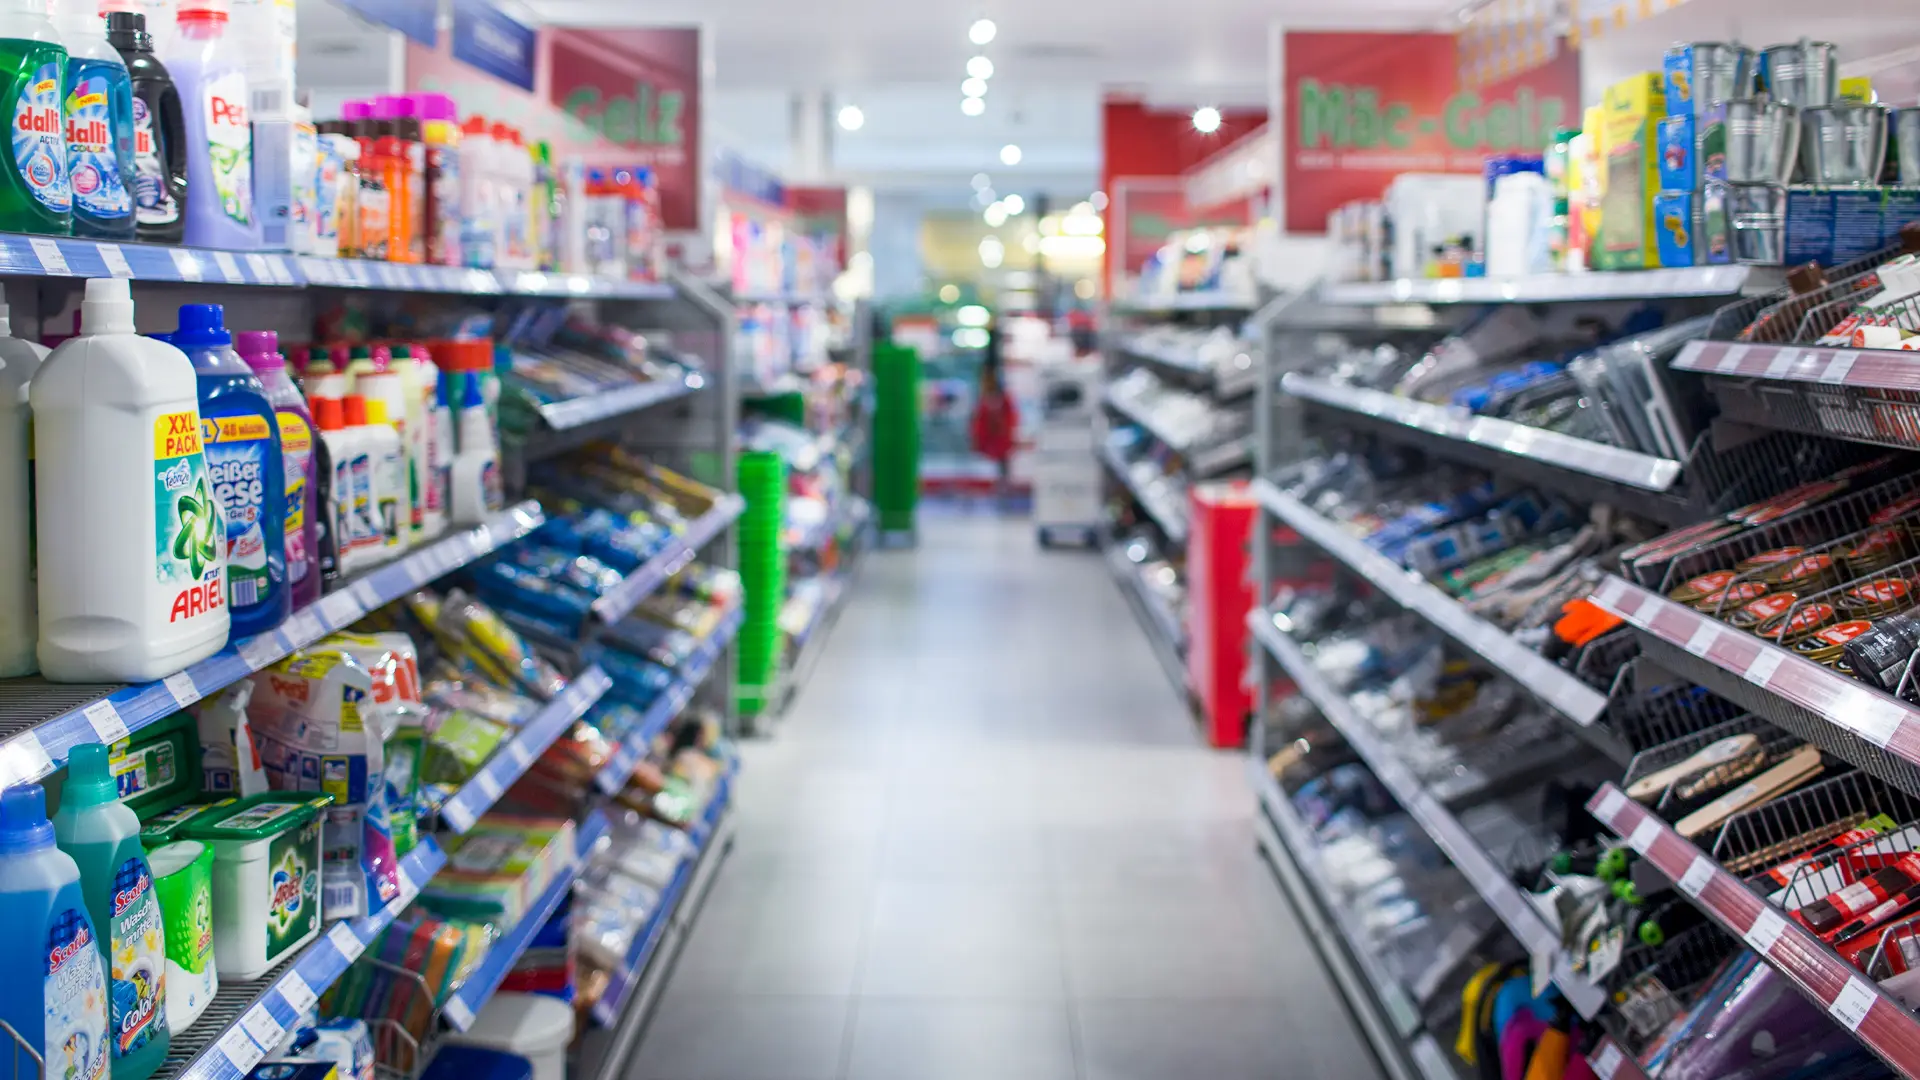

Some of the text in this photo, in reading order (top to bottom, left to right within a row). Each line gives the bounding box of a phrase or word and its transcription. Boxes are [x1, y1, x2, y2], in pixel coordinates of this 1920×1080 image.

[18, 107, 59, 134] dalli
[66, 120, 106, 144] dalli
[71, 144, 106, 153] COLOR
[168, 413, 195, 435] XXL
[166, 434, 198, 456] PACK
[208, 460, 260, 483] eißer
[169, 578, 224, 623] ARIEL
[271, 876, 300, 909] ARIEL
[122, 992, 155, 1034] Color
